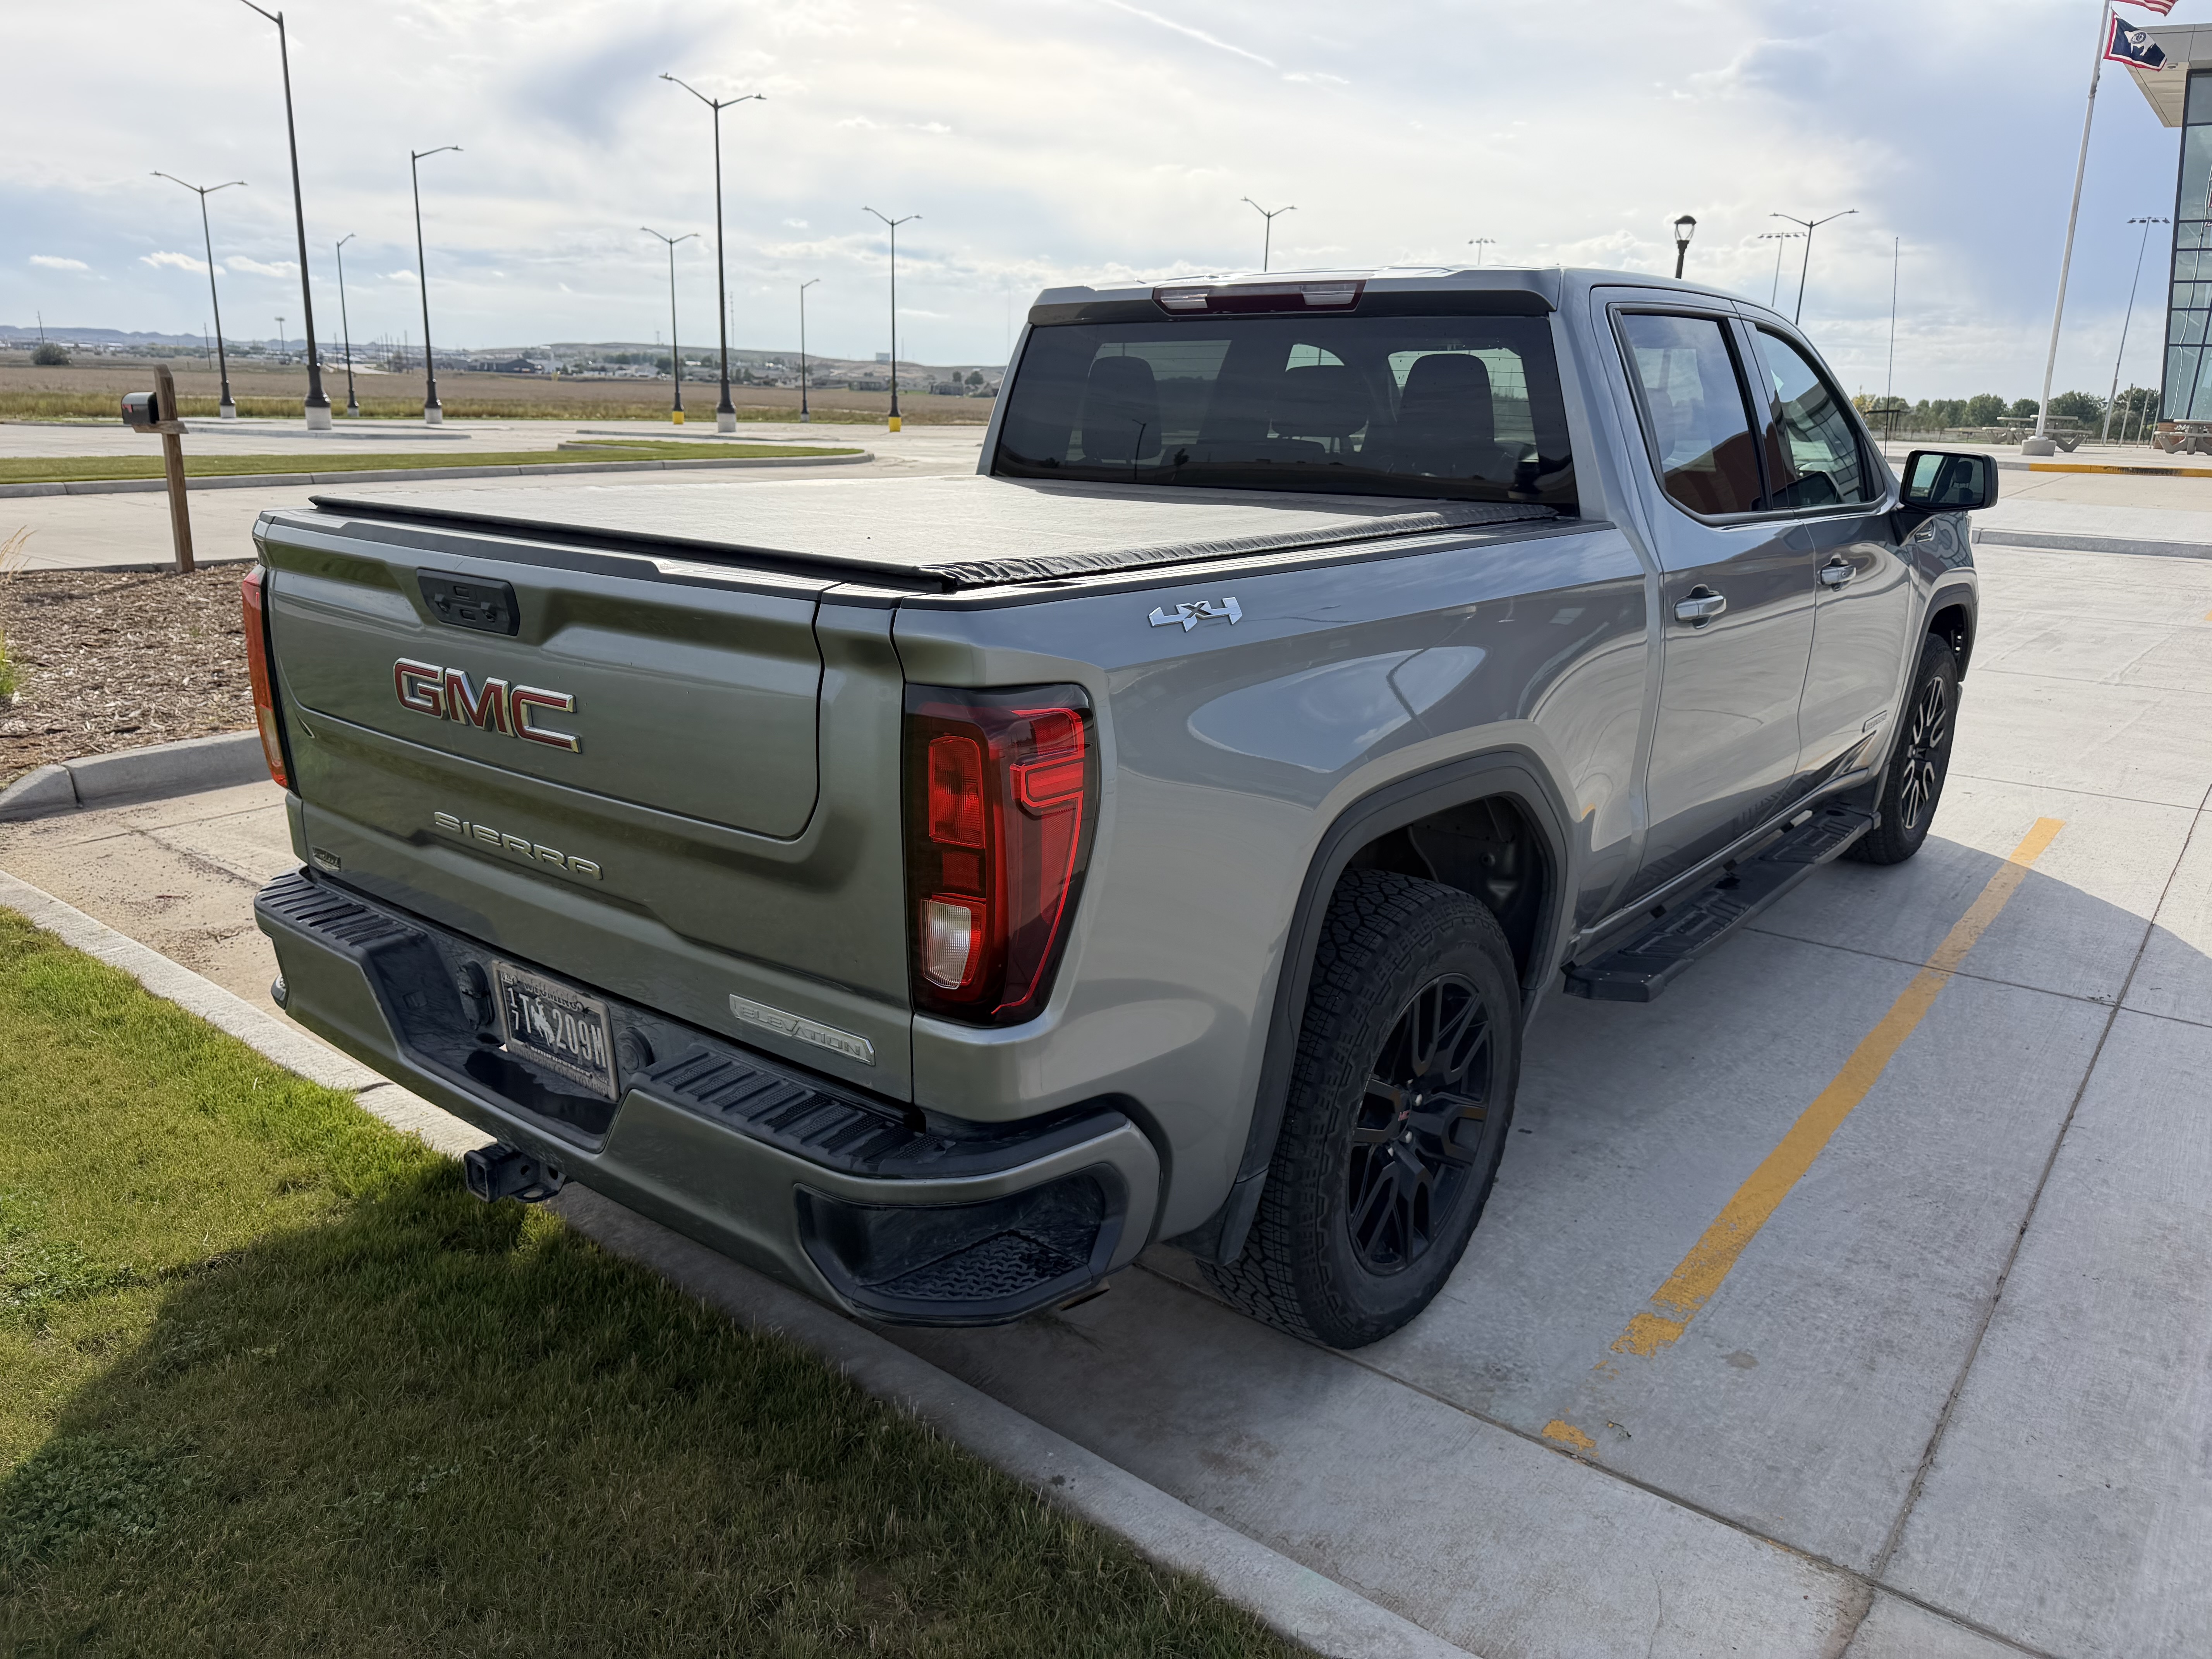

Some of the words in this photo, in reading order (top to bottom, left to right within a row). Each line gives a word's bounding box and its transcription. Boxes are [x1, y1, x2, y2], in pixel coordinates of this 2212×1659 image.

[393, 658, 582, 753] GMC
[434, 811, 603, 880] SIERRA
[743, 1008, 860, 1056] ELEVATION
